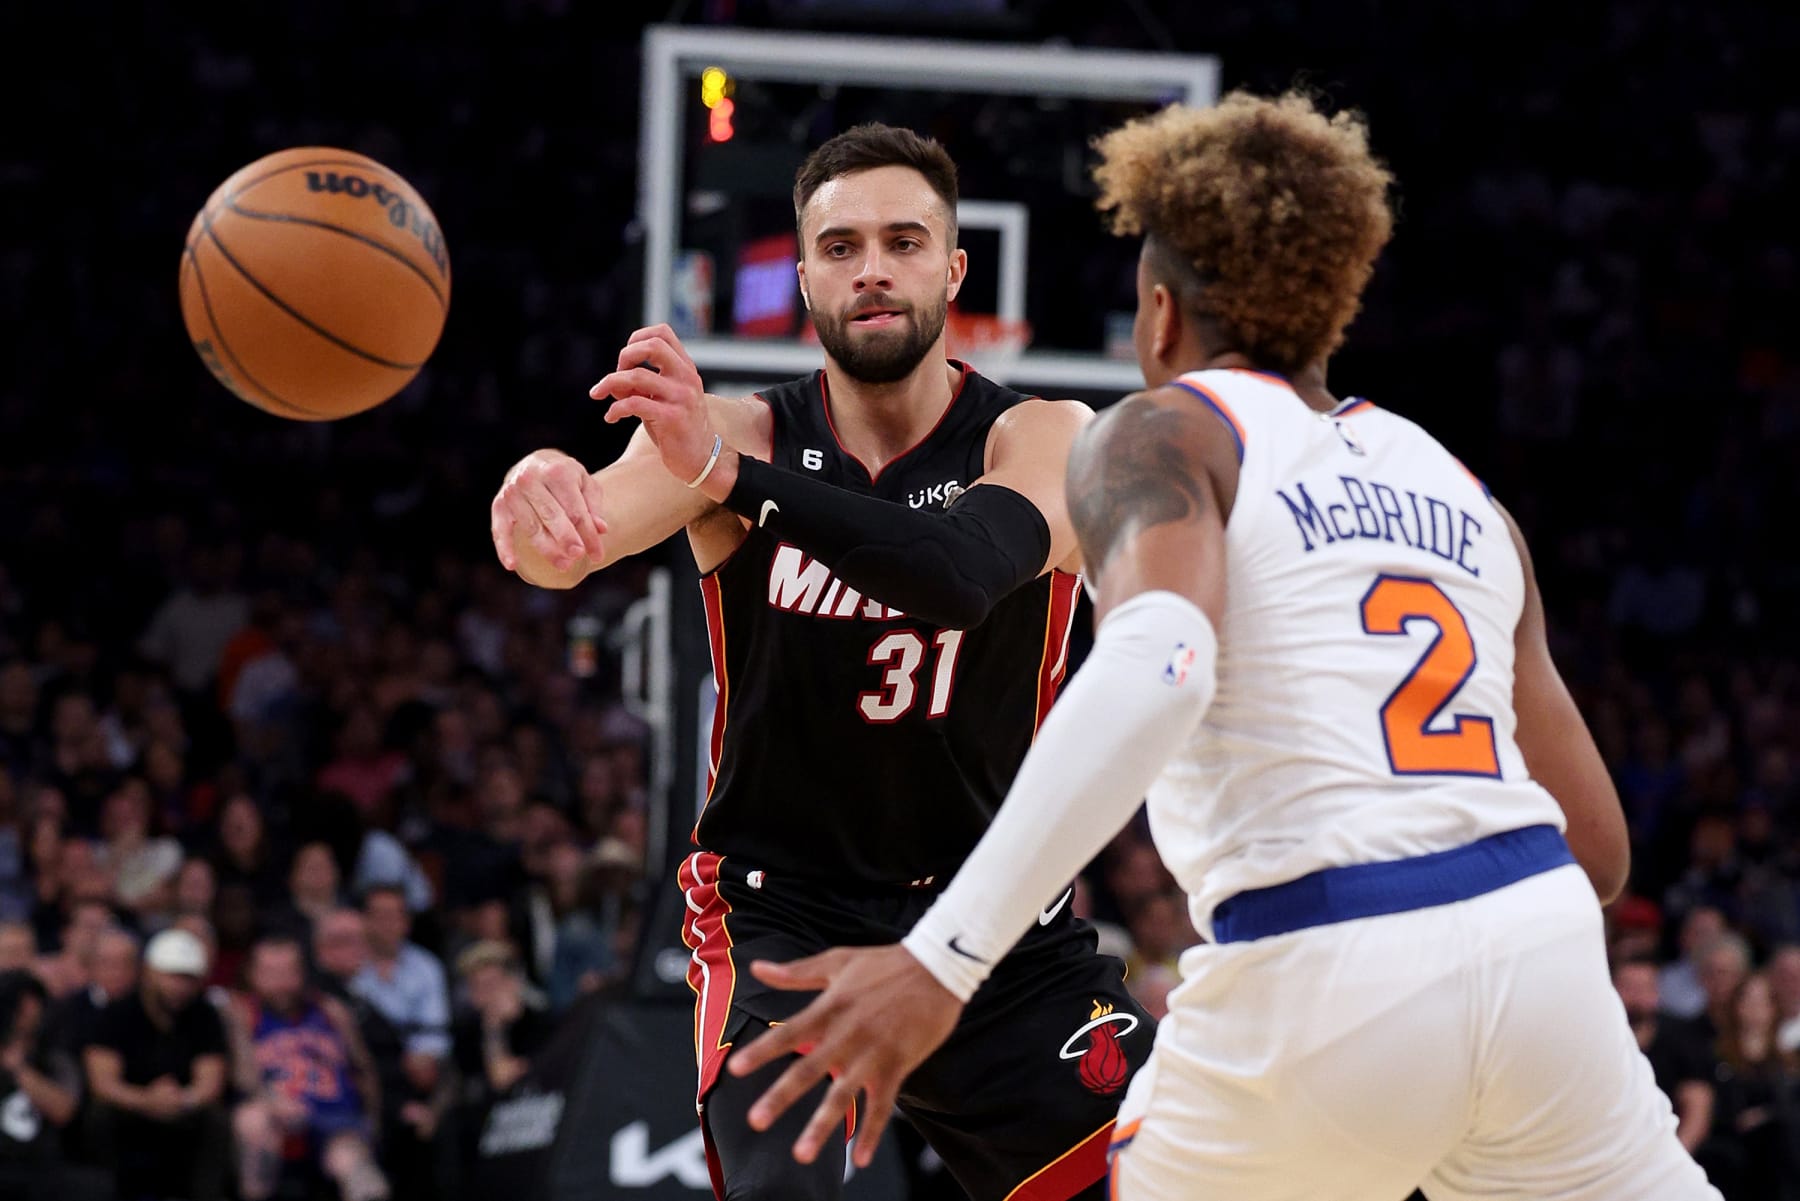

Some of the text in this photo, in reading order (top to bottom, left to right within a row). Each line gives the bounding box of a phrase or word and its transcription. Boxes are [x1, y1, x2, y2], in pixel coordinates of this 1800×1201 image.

[802, 449, 823, 471] 6
[1276, 475, 1482, 577] McBRIDE
[856, 628, 966, 724] 31
[1360, 572, 1503, 781] 2
